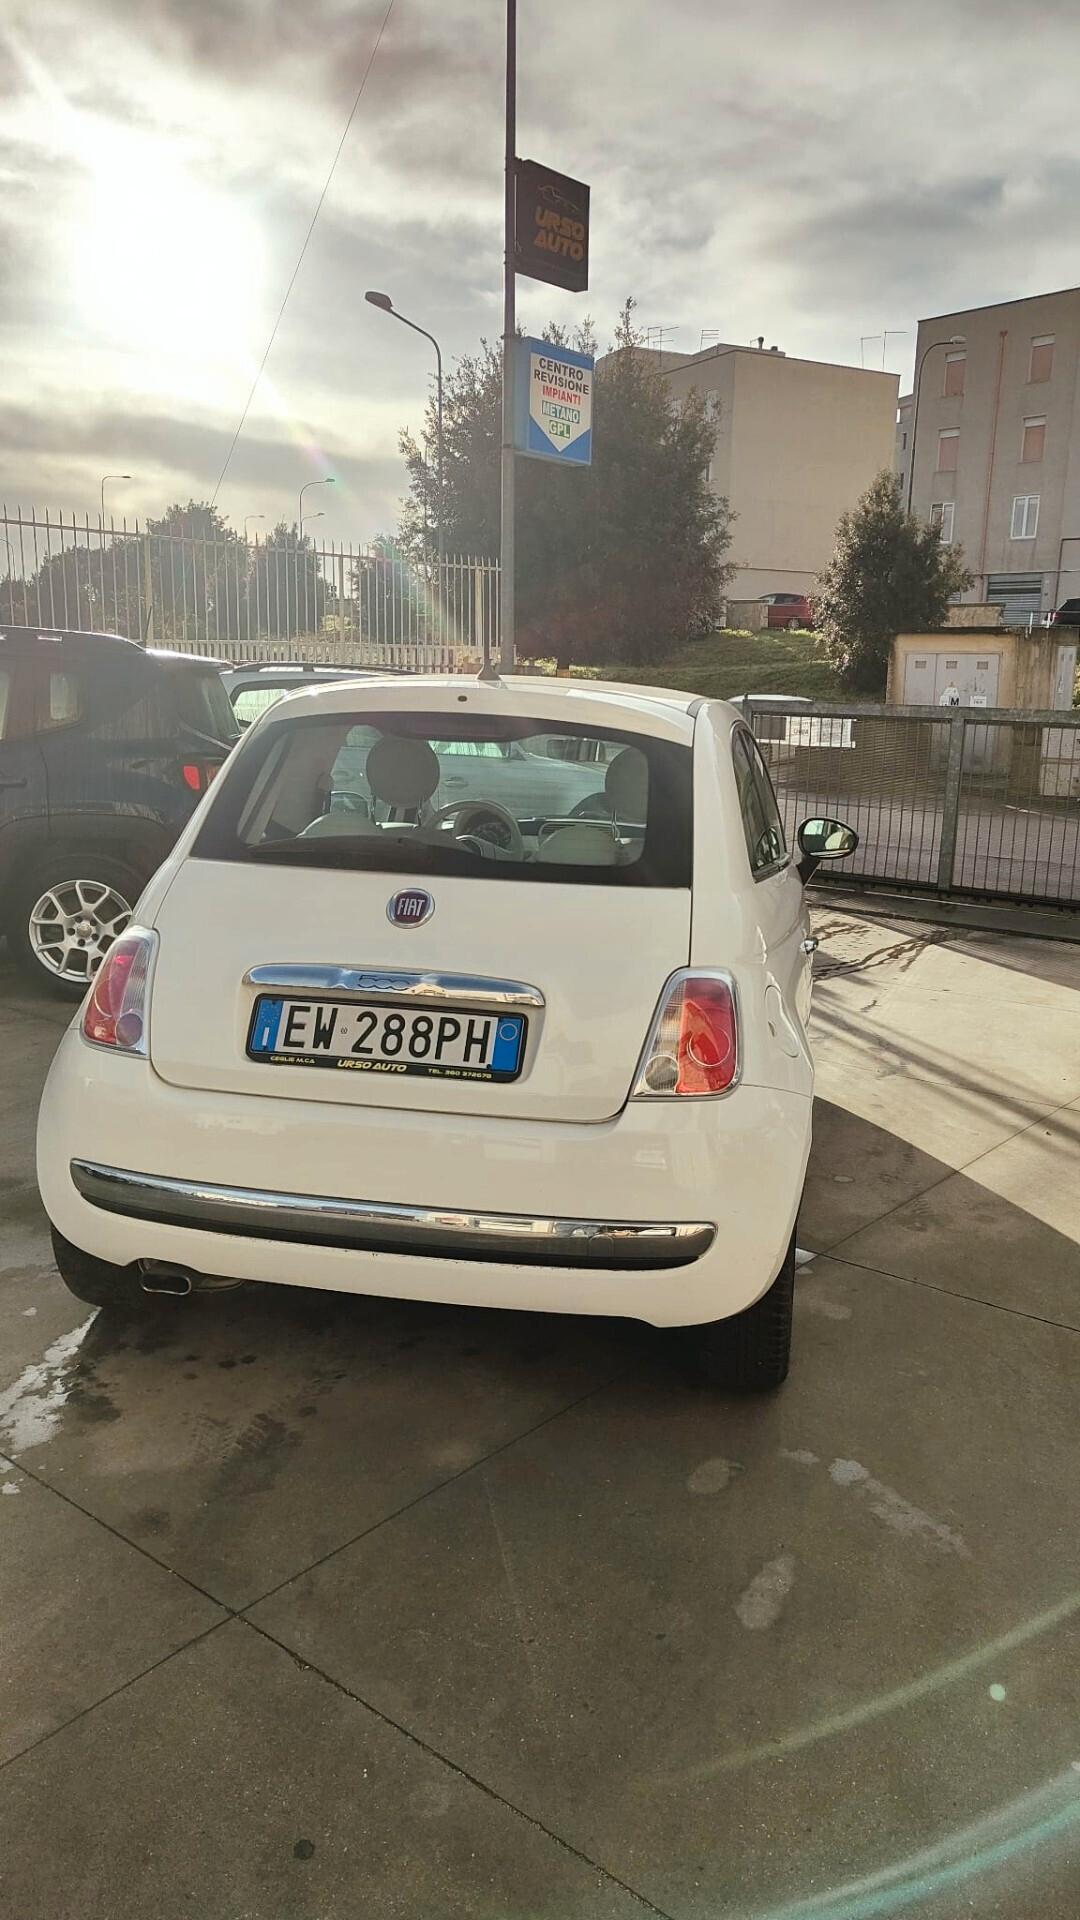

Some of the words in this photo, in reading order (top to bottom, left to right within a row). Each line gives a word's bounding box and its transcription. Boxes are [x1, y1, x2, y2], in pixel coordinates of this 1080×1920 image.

[535, 205, 585, 241] URSO
[533, 228, 584, 261] AUTO
[539, 358, 584, 381] CENTRO
[534, 369, 590, 395] REVISIONE
[542, 385, 582, 406] IMPIANTI
[542, 402, 580, 422] METANO
[549, 420, 570, 438] GPL
[397, 898, 426, 917] FIAT
[357, 974, 410, 991] 500
[283, 1005, 339, 1050] EW
[351, 1011, 491, 1063] 288PH
[337, 1059, 372, 1069] URSO
[373, 1063, 407, 1072] AUTO
